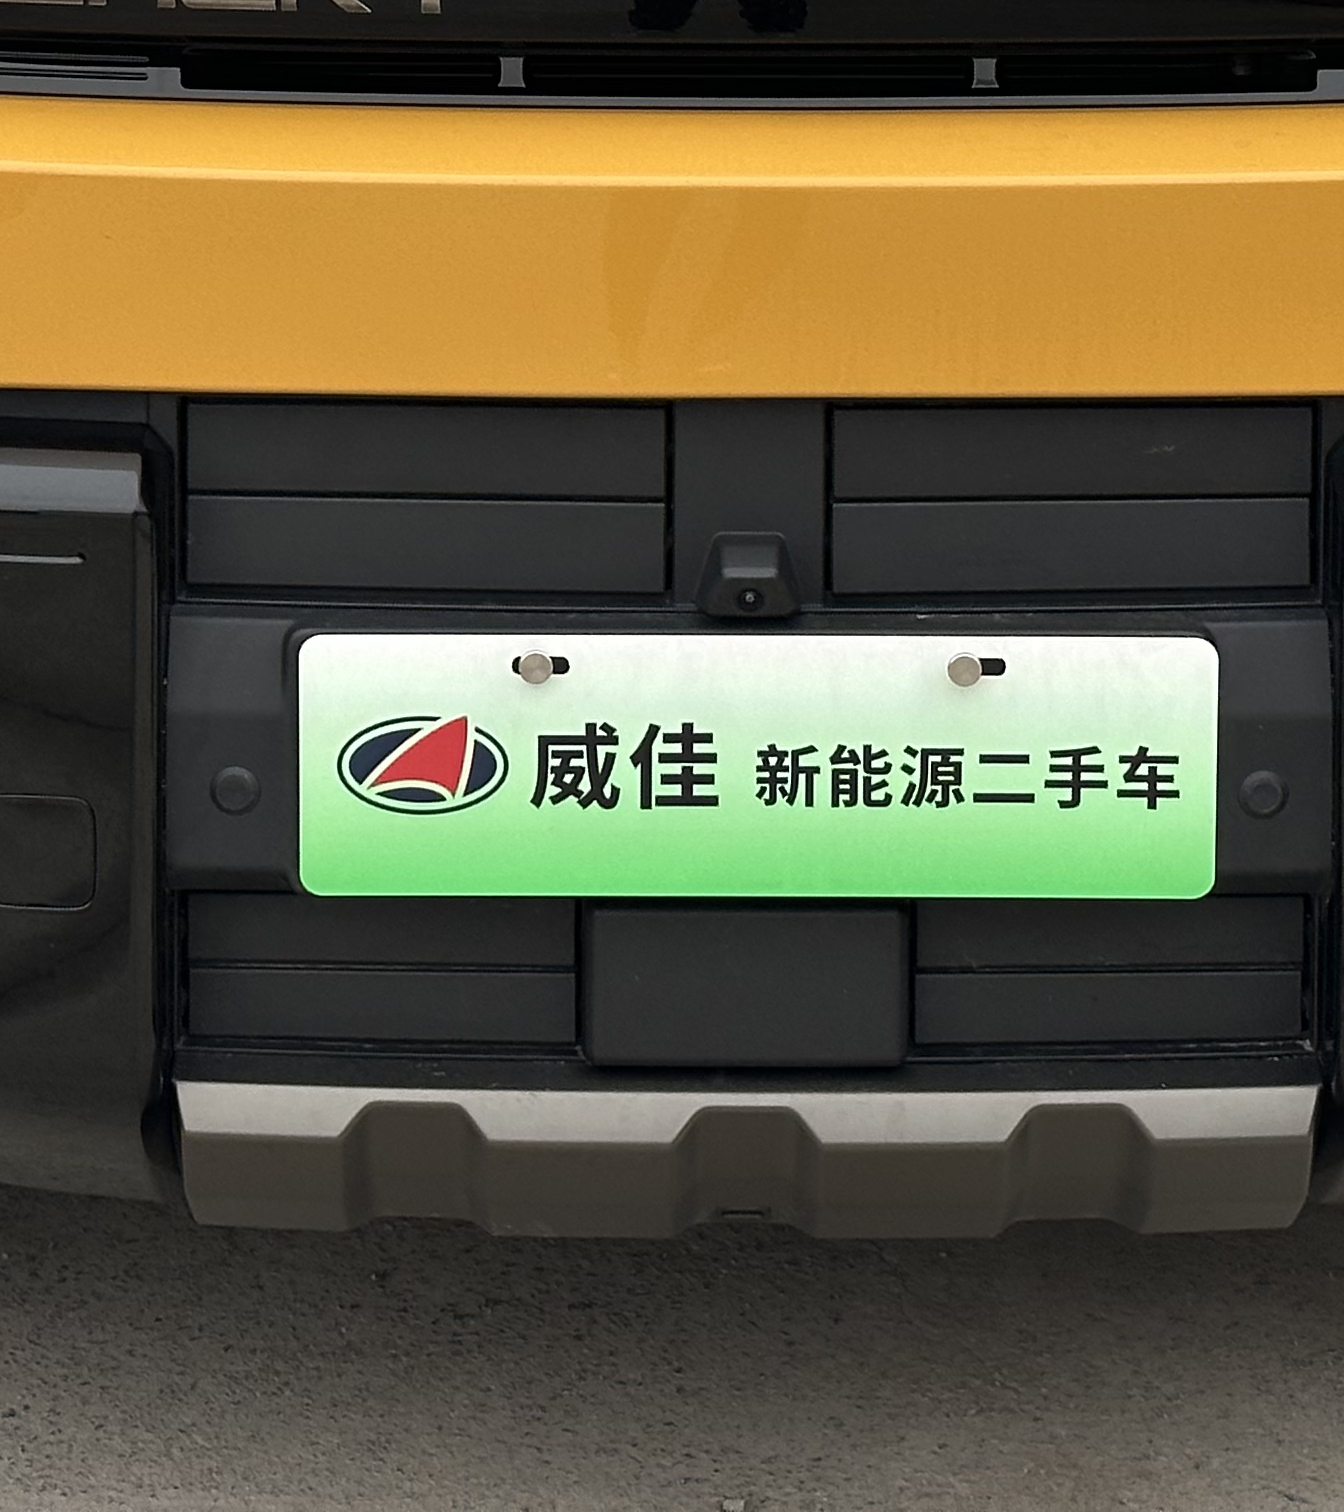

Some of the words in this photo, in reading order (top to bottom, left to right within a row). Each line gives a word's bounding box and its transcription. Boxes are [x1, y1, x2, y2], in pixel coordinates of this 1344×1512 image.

[529, 722, 720, 810] 威佳
[755, 743, 1180, 810] 新能源二手车
